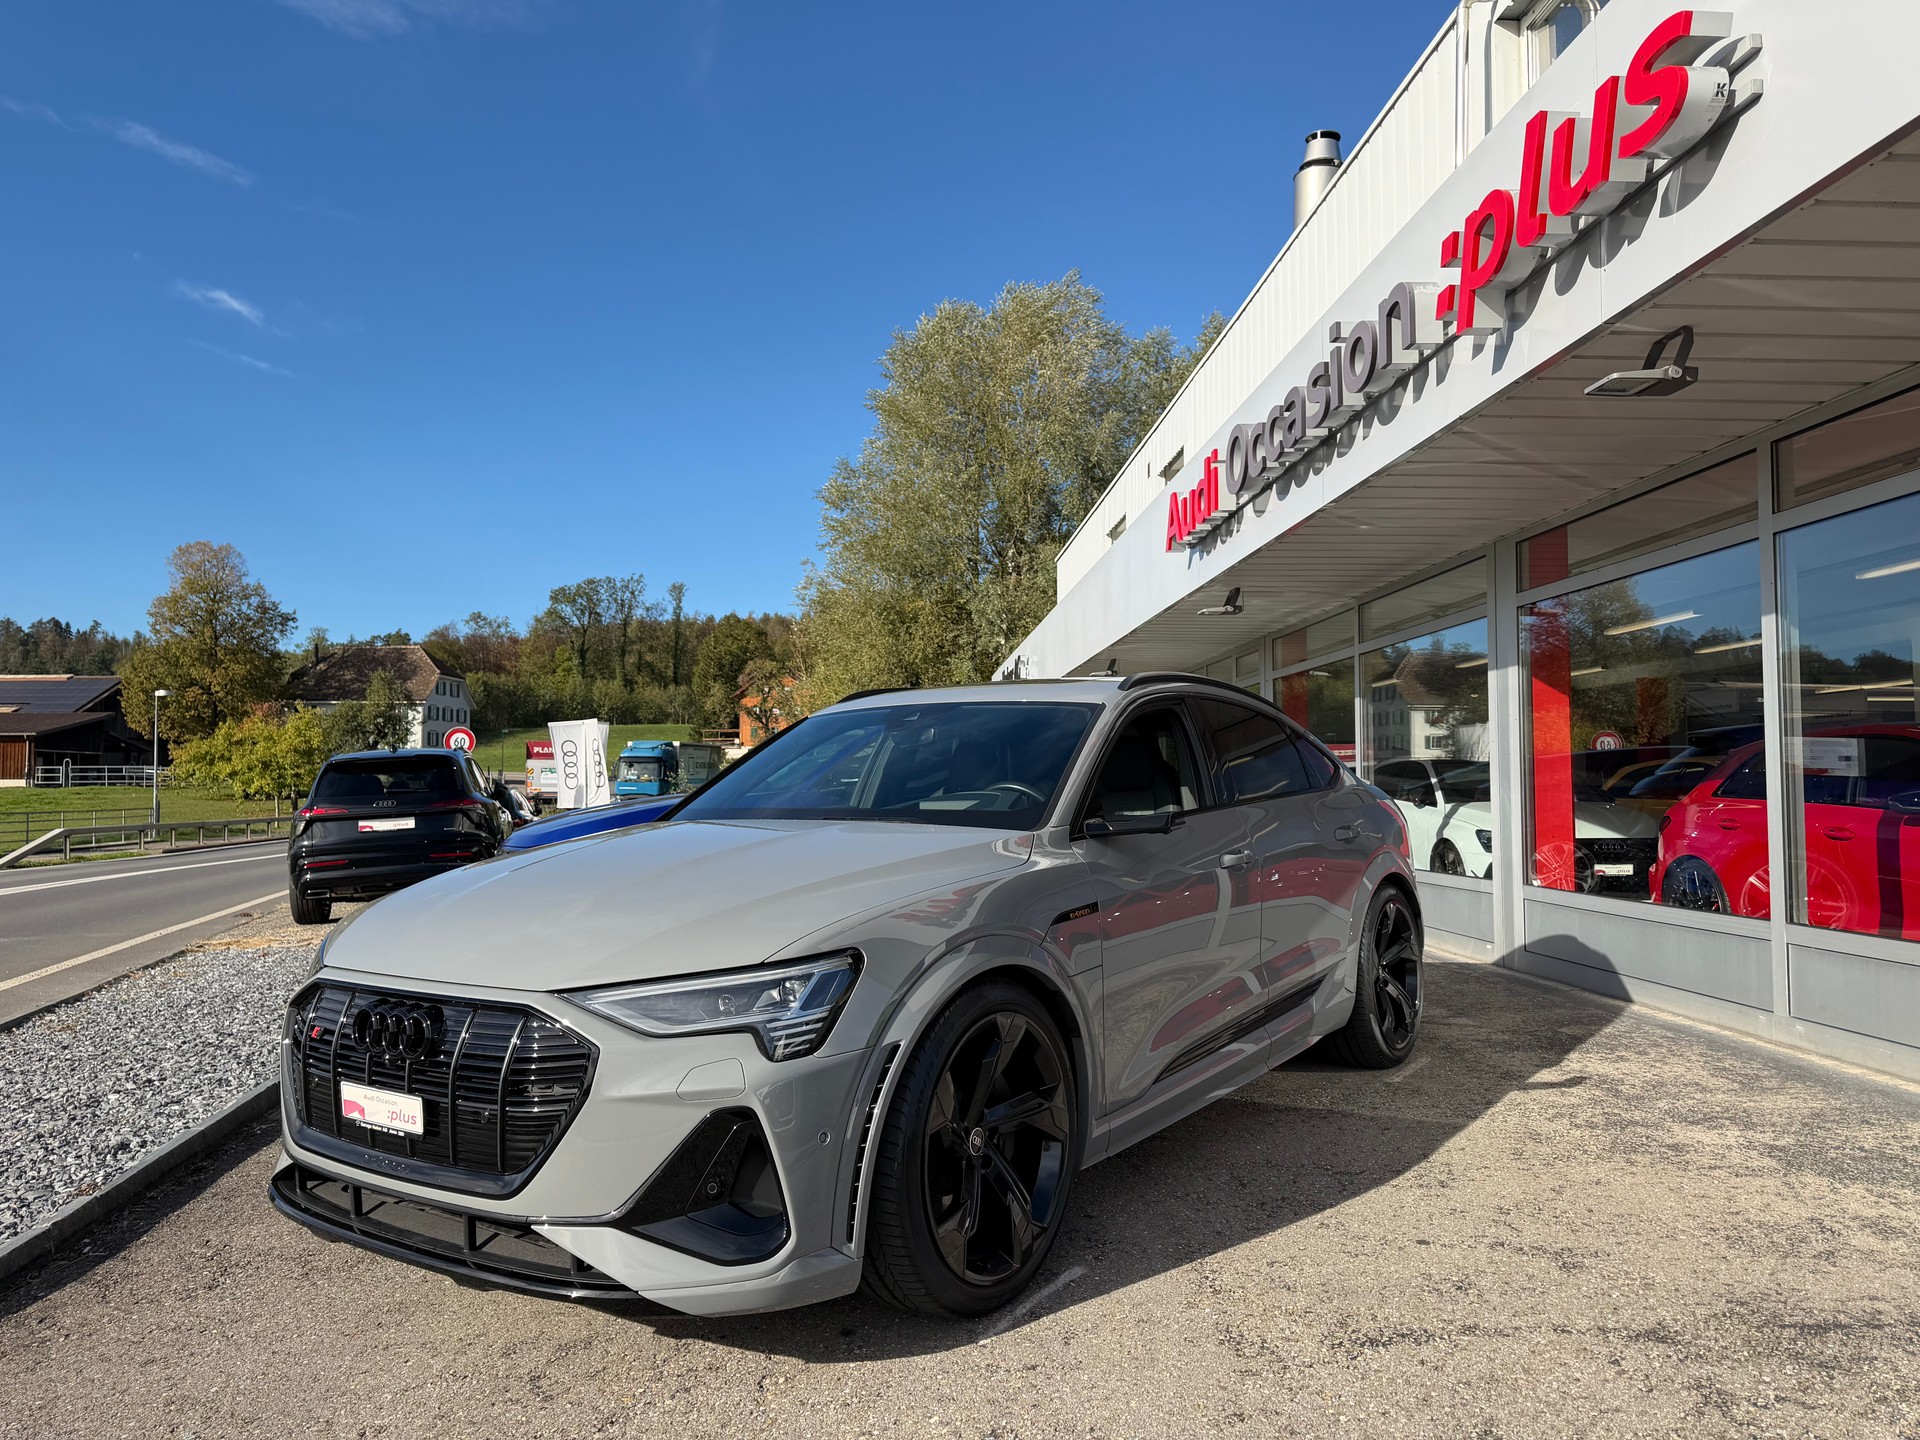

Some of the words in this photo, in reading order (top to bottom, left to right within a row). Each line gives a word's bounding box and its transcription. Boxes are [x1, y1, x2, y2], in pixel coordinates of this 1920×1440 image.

[1166, 448, 1219, 552] Audi
[1226, 281, 1416, 496] Occasion
[1435, 10, 1694, 336] :plus
[453, 737, 466, 747] 60
[363, 1094, 376, 1102] Audi
[376, 1096, 398, 1106] Occasion
[387, 1109, 417, 1124] :plus
